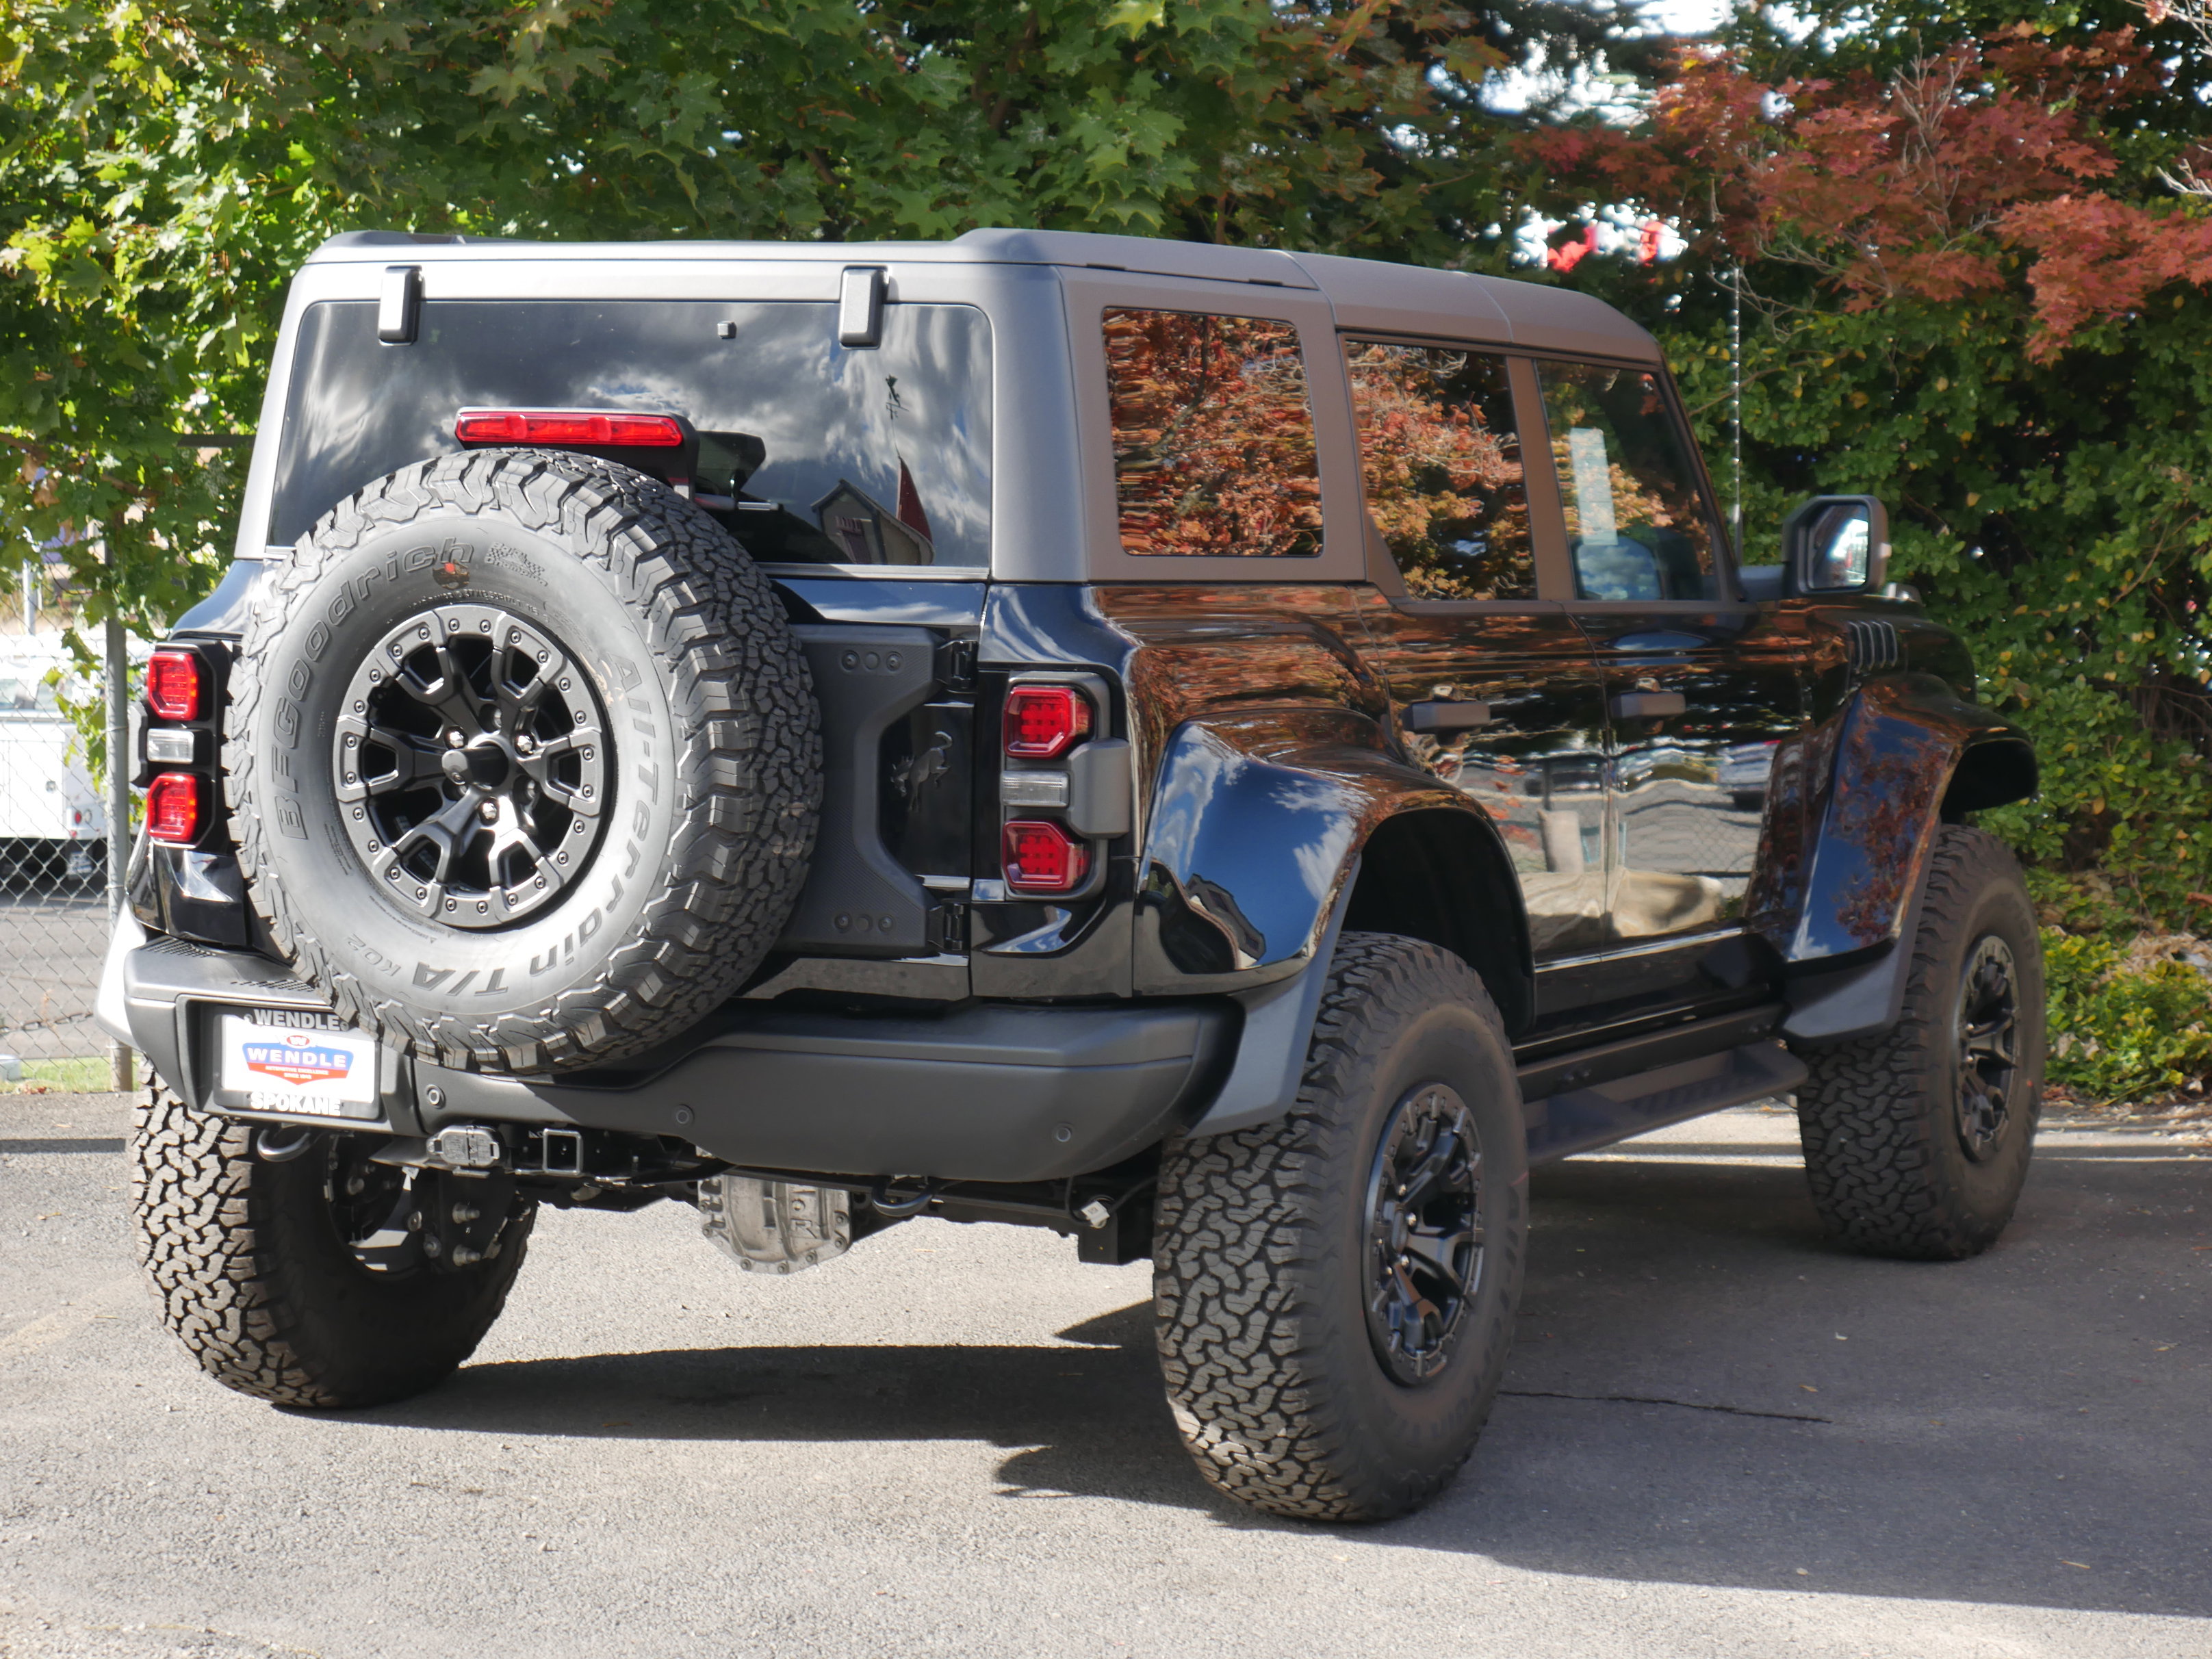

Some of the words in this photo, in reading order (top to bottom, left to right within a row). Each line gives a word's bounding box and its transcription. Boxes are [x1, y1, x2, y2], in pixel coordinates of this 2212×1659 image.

[272, 537, 474, 840] BFGoodrich
[530, 652, 659, 976] All-Terrain
[346, 932, 402, 977] KO2
[412, 961, 509, 997] T/A
[253, 1009, 341, 1031] WENDLE
[246, 1046, 347, 1068] WENDLE
[250, 1091, 341, 1116] SPOKANE
